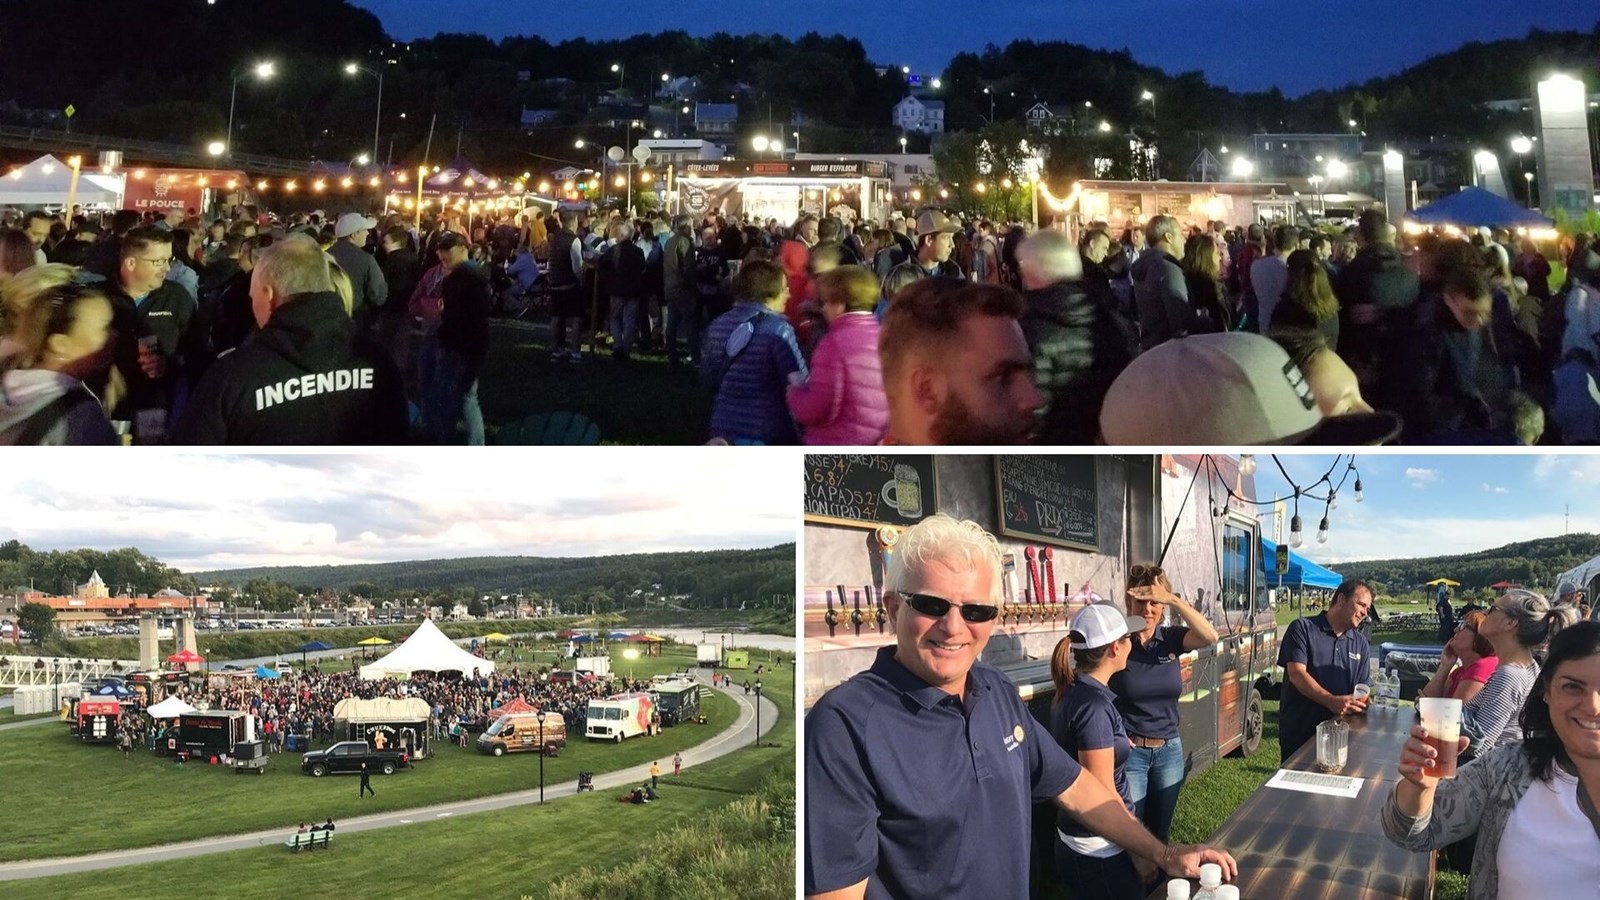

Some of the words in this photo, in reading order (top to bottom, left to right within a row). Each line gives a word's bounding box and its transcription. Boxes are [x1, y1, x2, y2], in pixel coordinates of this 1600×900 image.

[811, 164, 829, 172] BURGER
[135, 199, 147, 207] LE
[149, 199, 185, 208] POUCE
[255, 368, 373, 411] INCENDIE
[1036, 500, 1063, 527] PRIX
